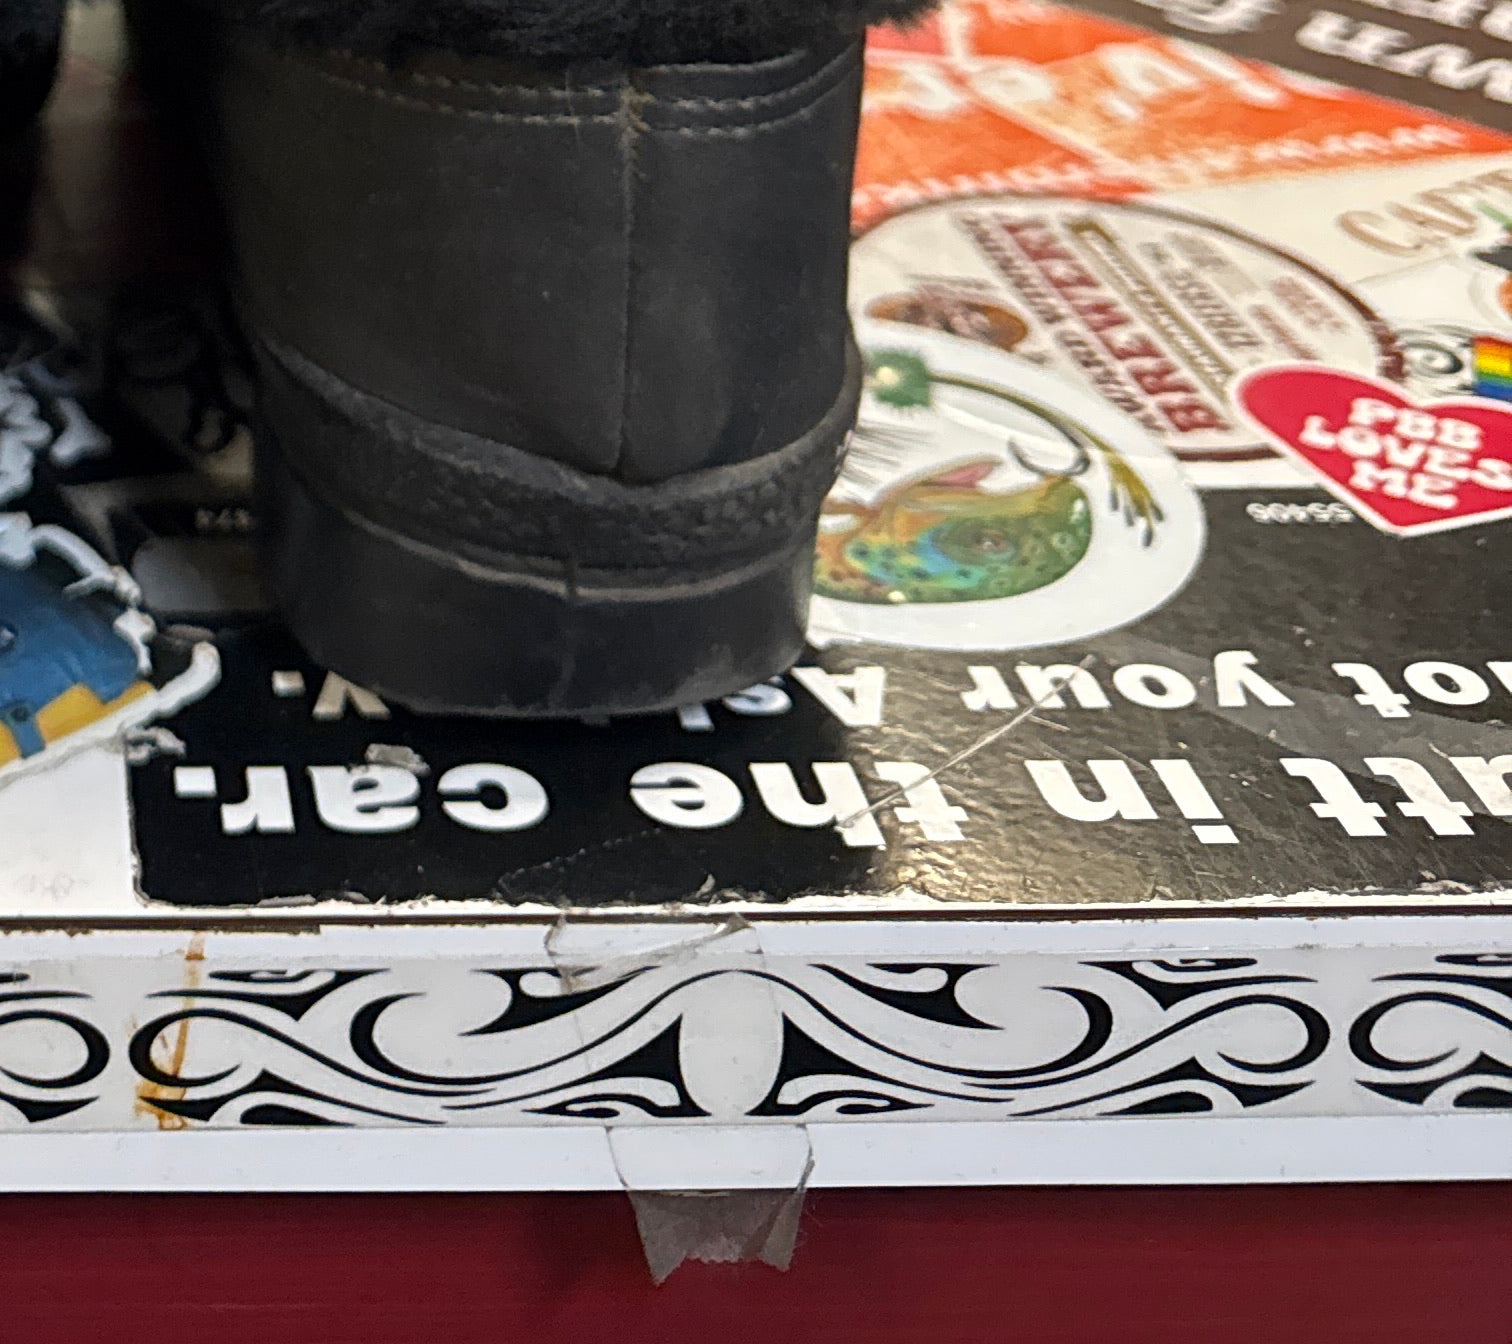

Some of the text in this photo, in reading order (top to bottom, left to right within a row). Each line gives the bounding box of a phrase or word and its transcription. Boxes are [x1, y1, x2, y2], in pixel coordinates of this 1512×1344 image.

[1297, 414, 1512, 491] LOVES
[1348, 459, 1460, 510] ME
[959, 649, 1296, 711] your
[1331, 659, 1512, 719] ot
[173, 760, 552, 837] car.
[628, 759, 971, 849] the
[1025, 758, 1241, 845] in
